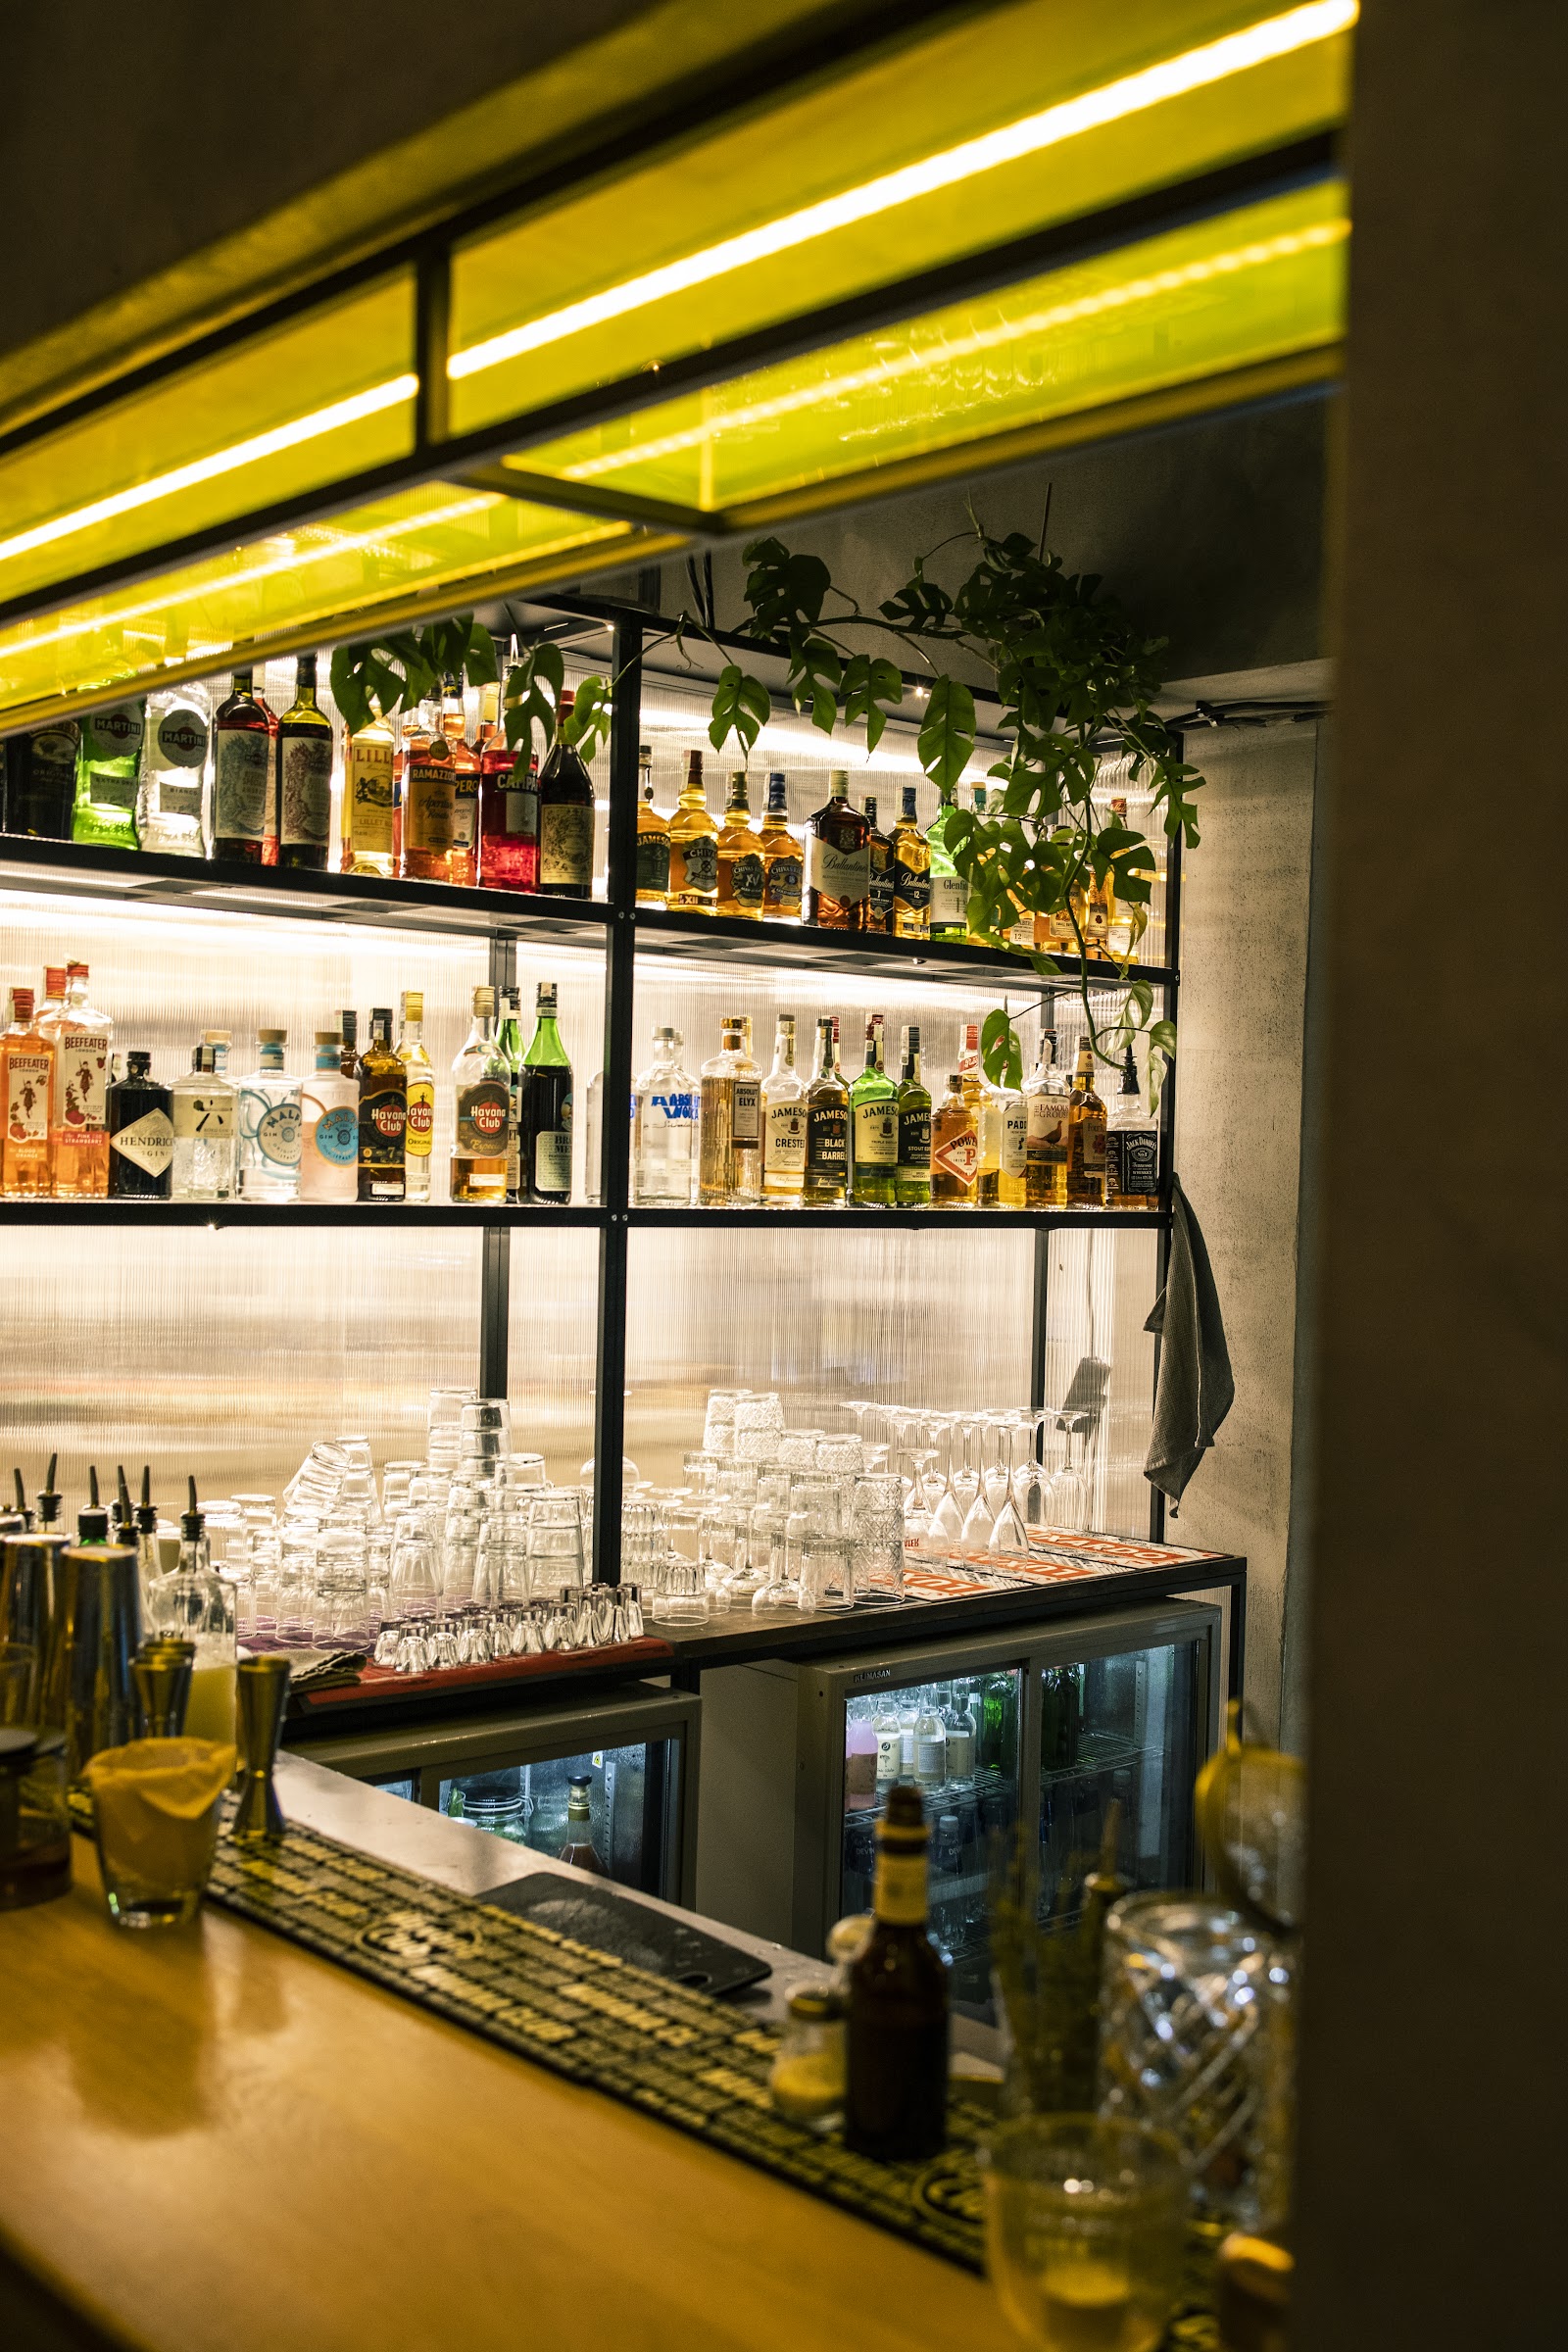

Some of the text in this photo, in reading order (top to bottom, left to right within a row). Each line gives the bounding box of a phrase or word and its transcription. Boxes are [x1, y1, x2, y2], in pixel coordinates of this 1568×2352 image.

[96, 719, 140, 734] MARTINI
[164, 731, 206, 746] MARTINI
[356, 748, 394, 764] LILL
[637, 835, 670, 847] JAMESO
[690, 849, 717, 858] CHIVA
[734, 865, 754, 874] CHIVAS
[771, 865, 793, 874] CHIVAS
[746, 874, 760, 887] XV
[65, 1037, 107, 1052] BEEFEATER
[9, 1057, 49, 1072] BEEFEATER
[739, 1097, 756, 1106] ELYX
[371, 1108, 407, 1121] Havana
[470, 1106, 506, 1117] Havana
[771, 1107, 807, 1119] JAMESO
[813, 1109, 848, 1123] JAMESO
[862, 1105, 899, 1119] JAMESO
[380, 1121, 402, 1132] Club
[412, 1117, 430, 1128] Club
[479, 1117, 501, 1128] Club
[120, 1136, 172, 1147] HENDRIC
[775, 1138, 806, 1149] CRESTE
[824, 1138, 845, 1148] BLACK
[1126, 1139, 1138, 1152] JACK
[387, 1147, 396, 1158] 7
[964, 1148, 976, 1166] P
